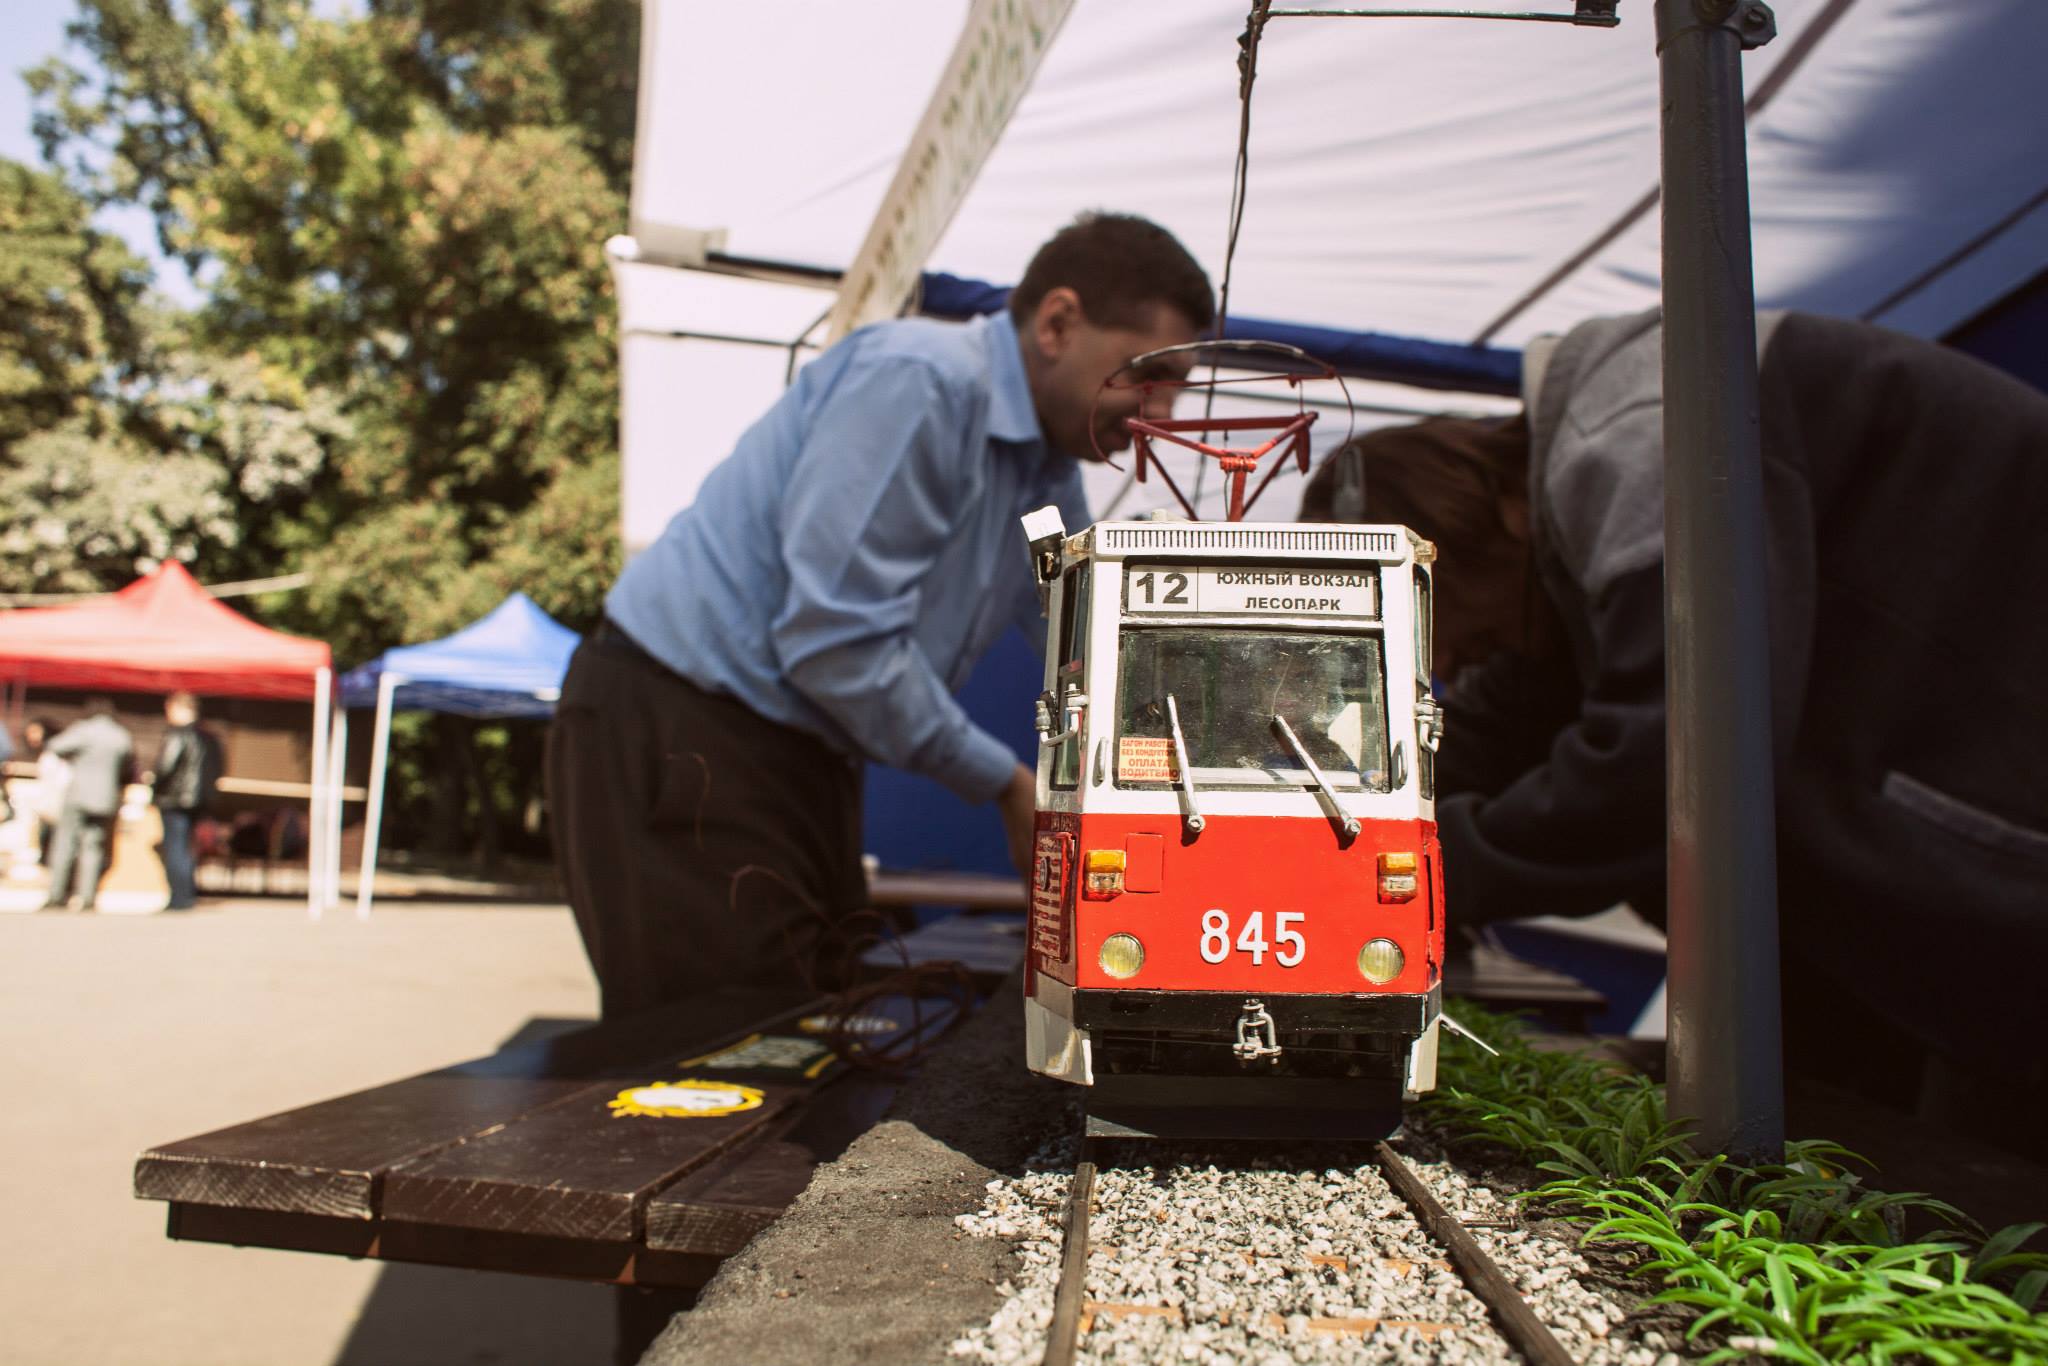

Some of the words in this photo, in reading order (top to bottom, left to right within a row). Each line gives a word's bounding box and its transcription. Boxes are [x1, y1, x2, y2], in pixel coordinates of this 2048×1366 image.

[1216, 571, 1294, 586] ЮЖНЫЙ
[1299, 574, 1369, 588] ВОКЗАЛ
[1136, 573, 1189, 604] 12
[1245, 597, 1341, 611] ЛЕСОПАРК
[1128, 759, 1170, 767] ОПЛАТА
[1120, 768, 1178, 777] ВОДИТЕЛЮ
[1200, 909, 1306, 968] 845
